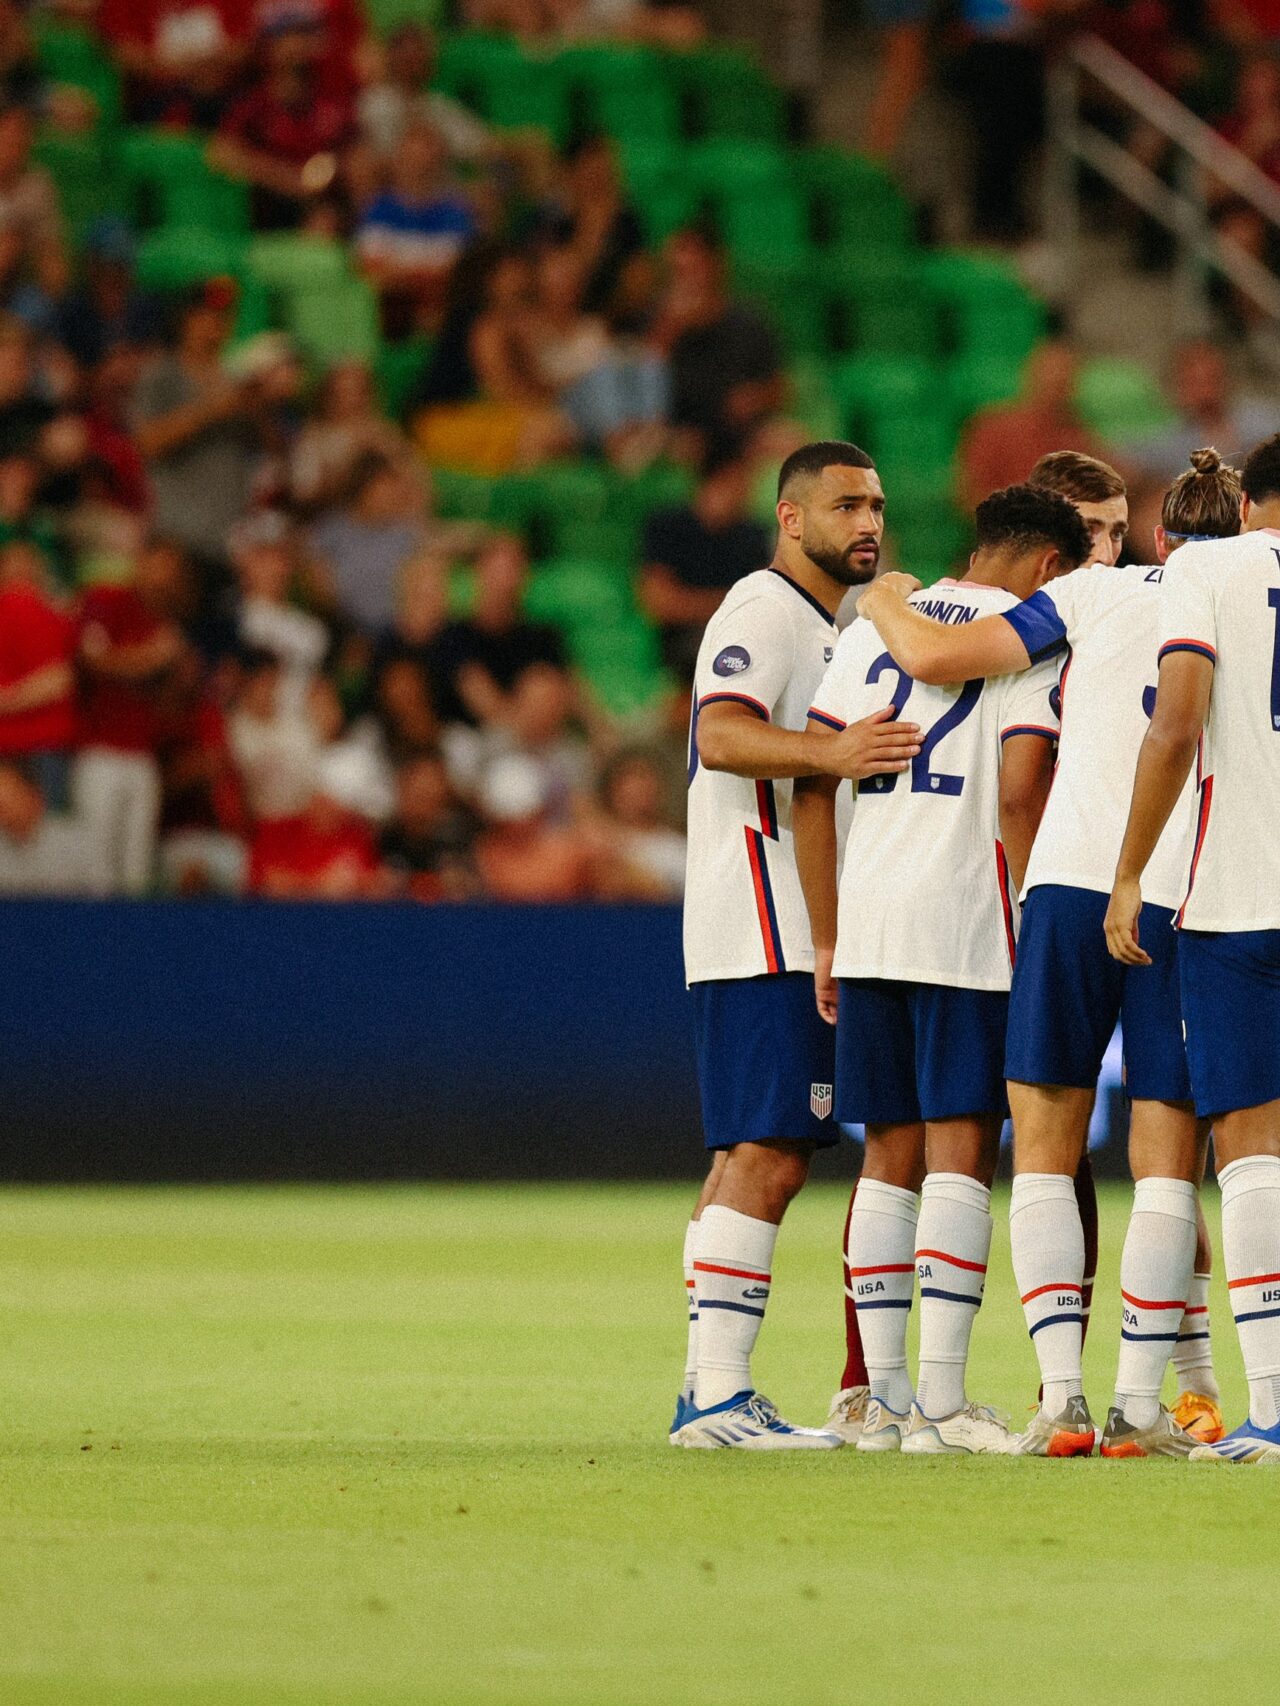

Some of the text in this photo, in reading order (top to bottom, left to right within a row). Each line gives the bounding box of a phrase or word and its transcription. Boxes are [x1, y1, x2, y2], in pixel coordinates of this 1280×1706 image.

[812, 1085, 831, 1098] USA
[918, 1264, 933, 1278] SA
[857, 1281, 885, 1295] USA
[1057, 1296, 1080, 1306] USA
